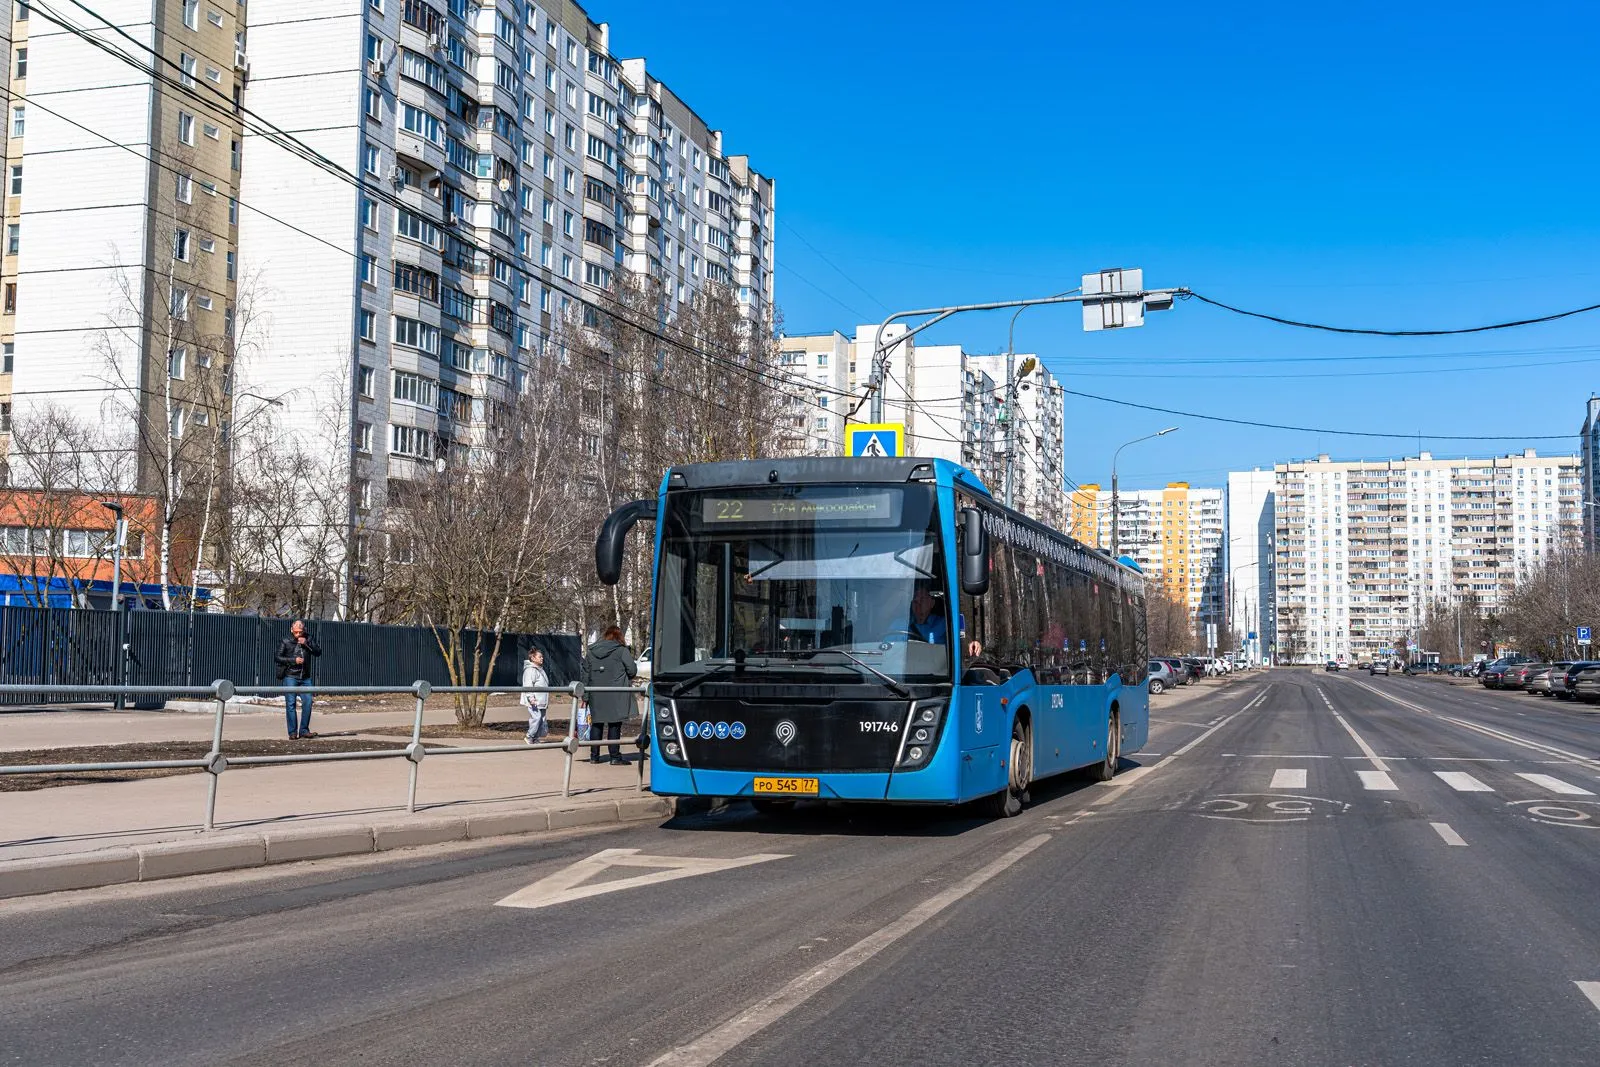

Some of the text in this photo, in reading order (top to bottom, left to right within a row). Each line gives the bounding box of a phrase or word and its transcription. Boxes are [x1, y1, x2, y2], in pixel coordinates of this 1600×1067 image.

[717, 501, 744, 519] 22
[1580, 628, 1588, 638] P
[859, 721, 898, 733] 191746
[777, 779, 798, 791] 545
[804, 779, 814, 788] 77
